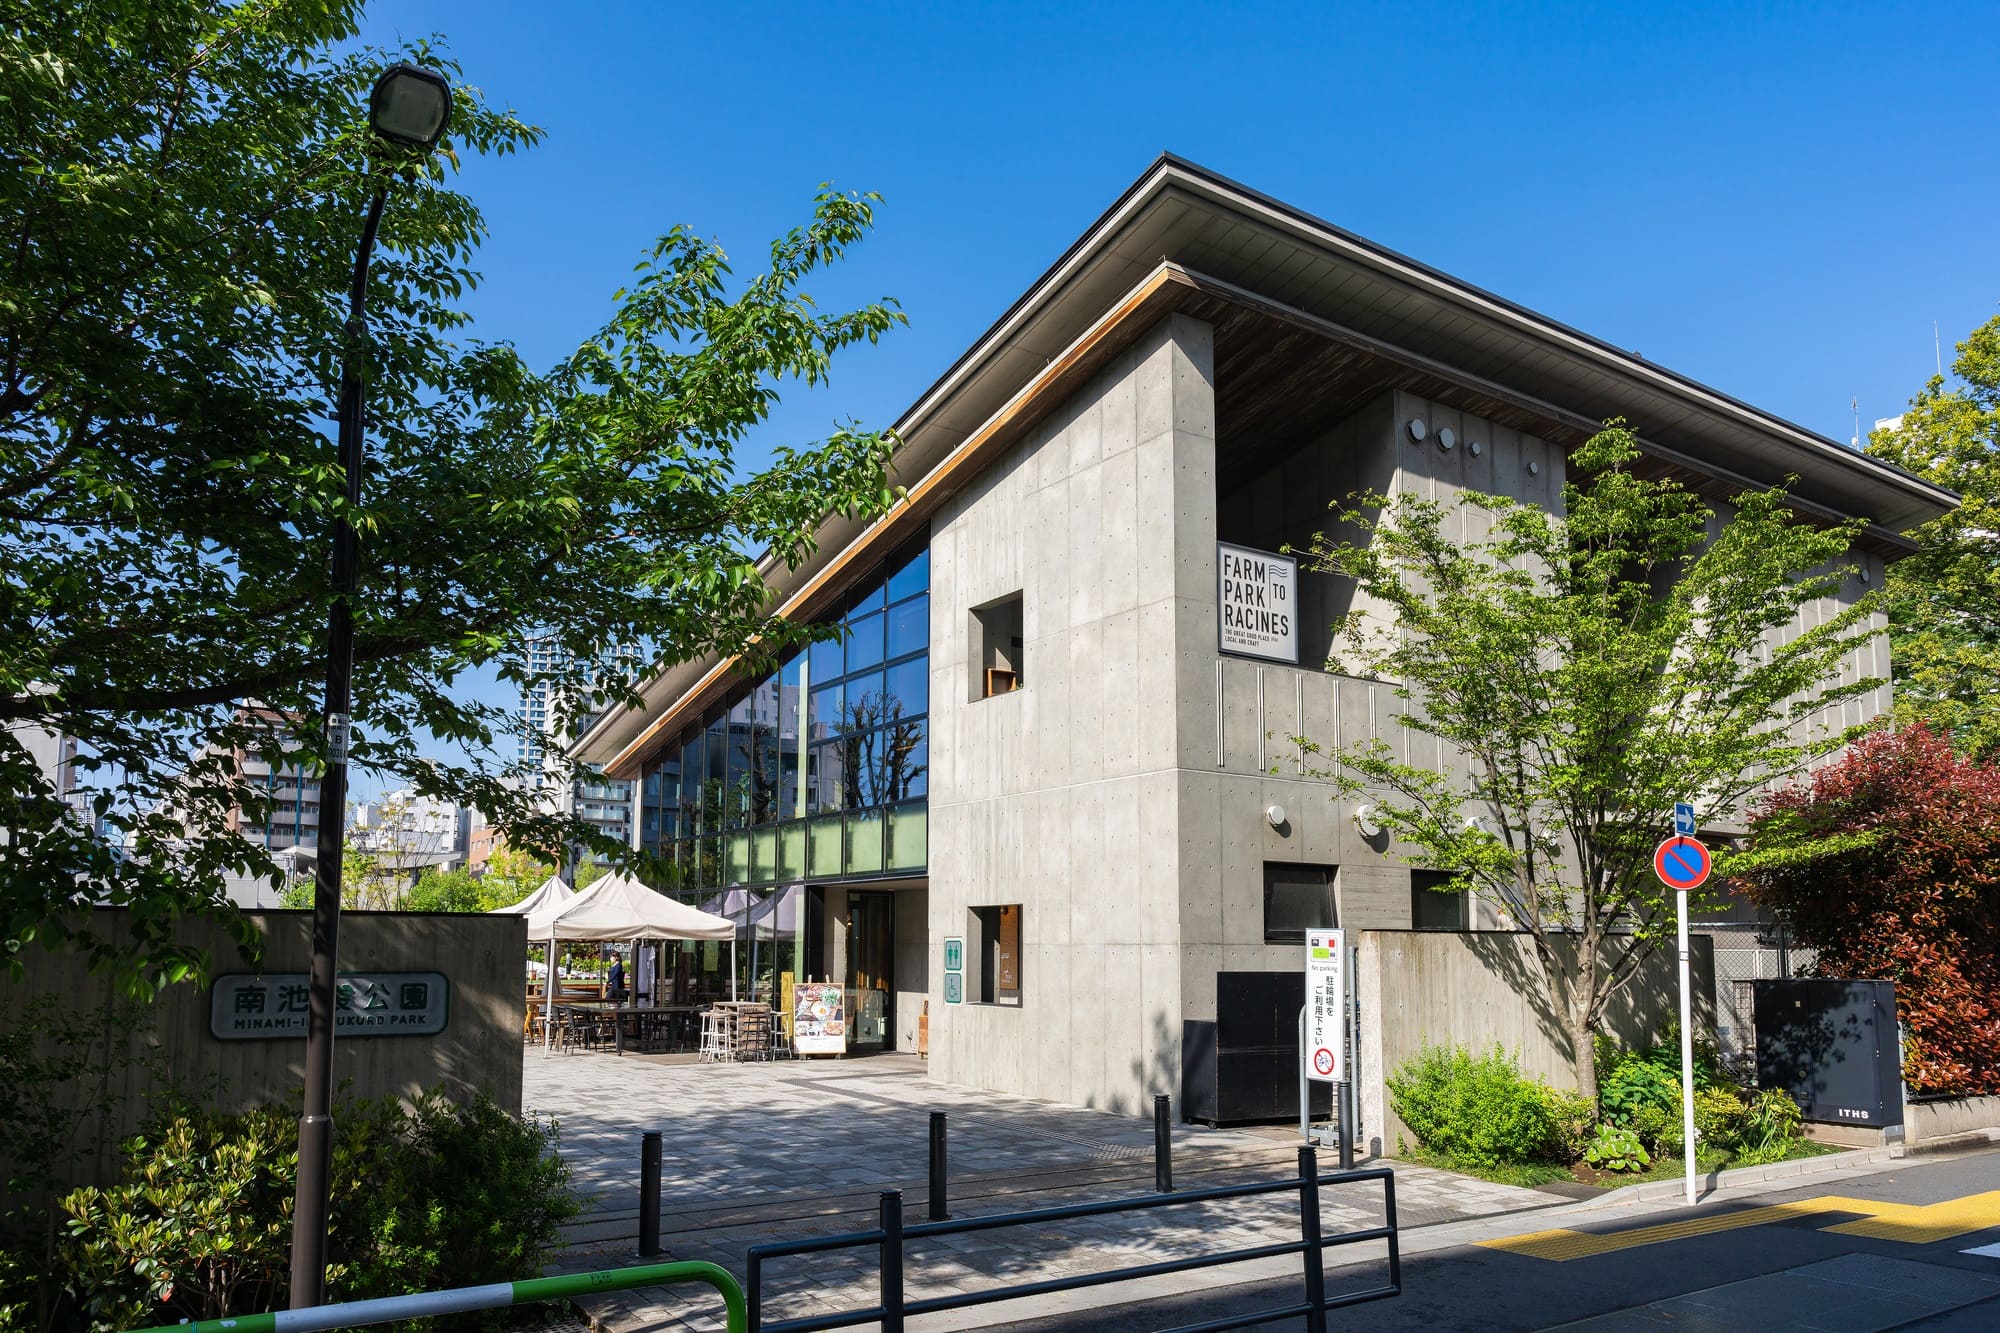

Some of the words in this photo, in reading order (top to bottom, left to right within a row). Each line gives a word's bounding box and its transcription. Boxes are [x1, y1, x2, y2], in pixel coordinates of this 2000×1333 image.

[1224, 554, 1265, 584] FARM
[1224, 579, 1265, 608] PARK
[1273, 583, 1286, 600] TO
[1225, 604, 1289, 636] RACINES
[1225, 635, 1237, 643] LOCAL
[335, 735, 343, 744] B
[1320, 965, 1338, 974] parking
[1326, 975, 1335, 1017] 駐輪場を
[234, 1015, 385, 1029] MINAMI-IUKURO
[390, 1015, 426, 1025] PARK
[1314, 985, 1324, 1046] ご利用下さい
[1838, 1108, 1869, 1119] ITHS
